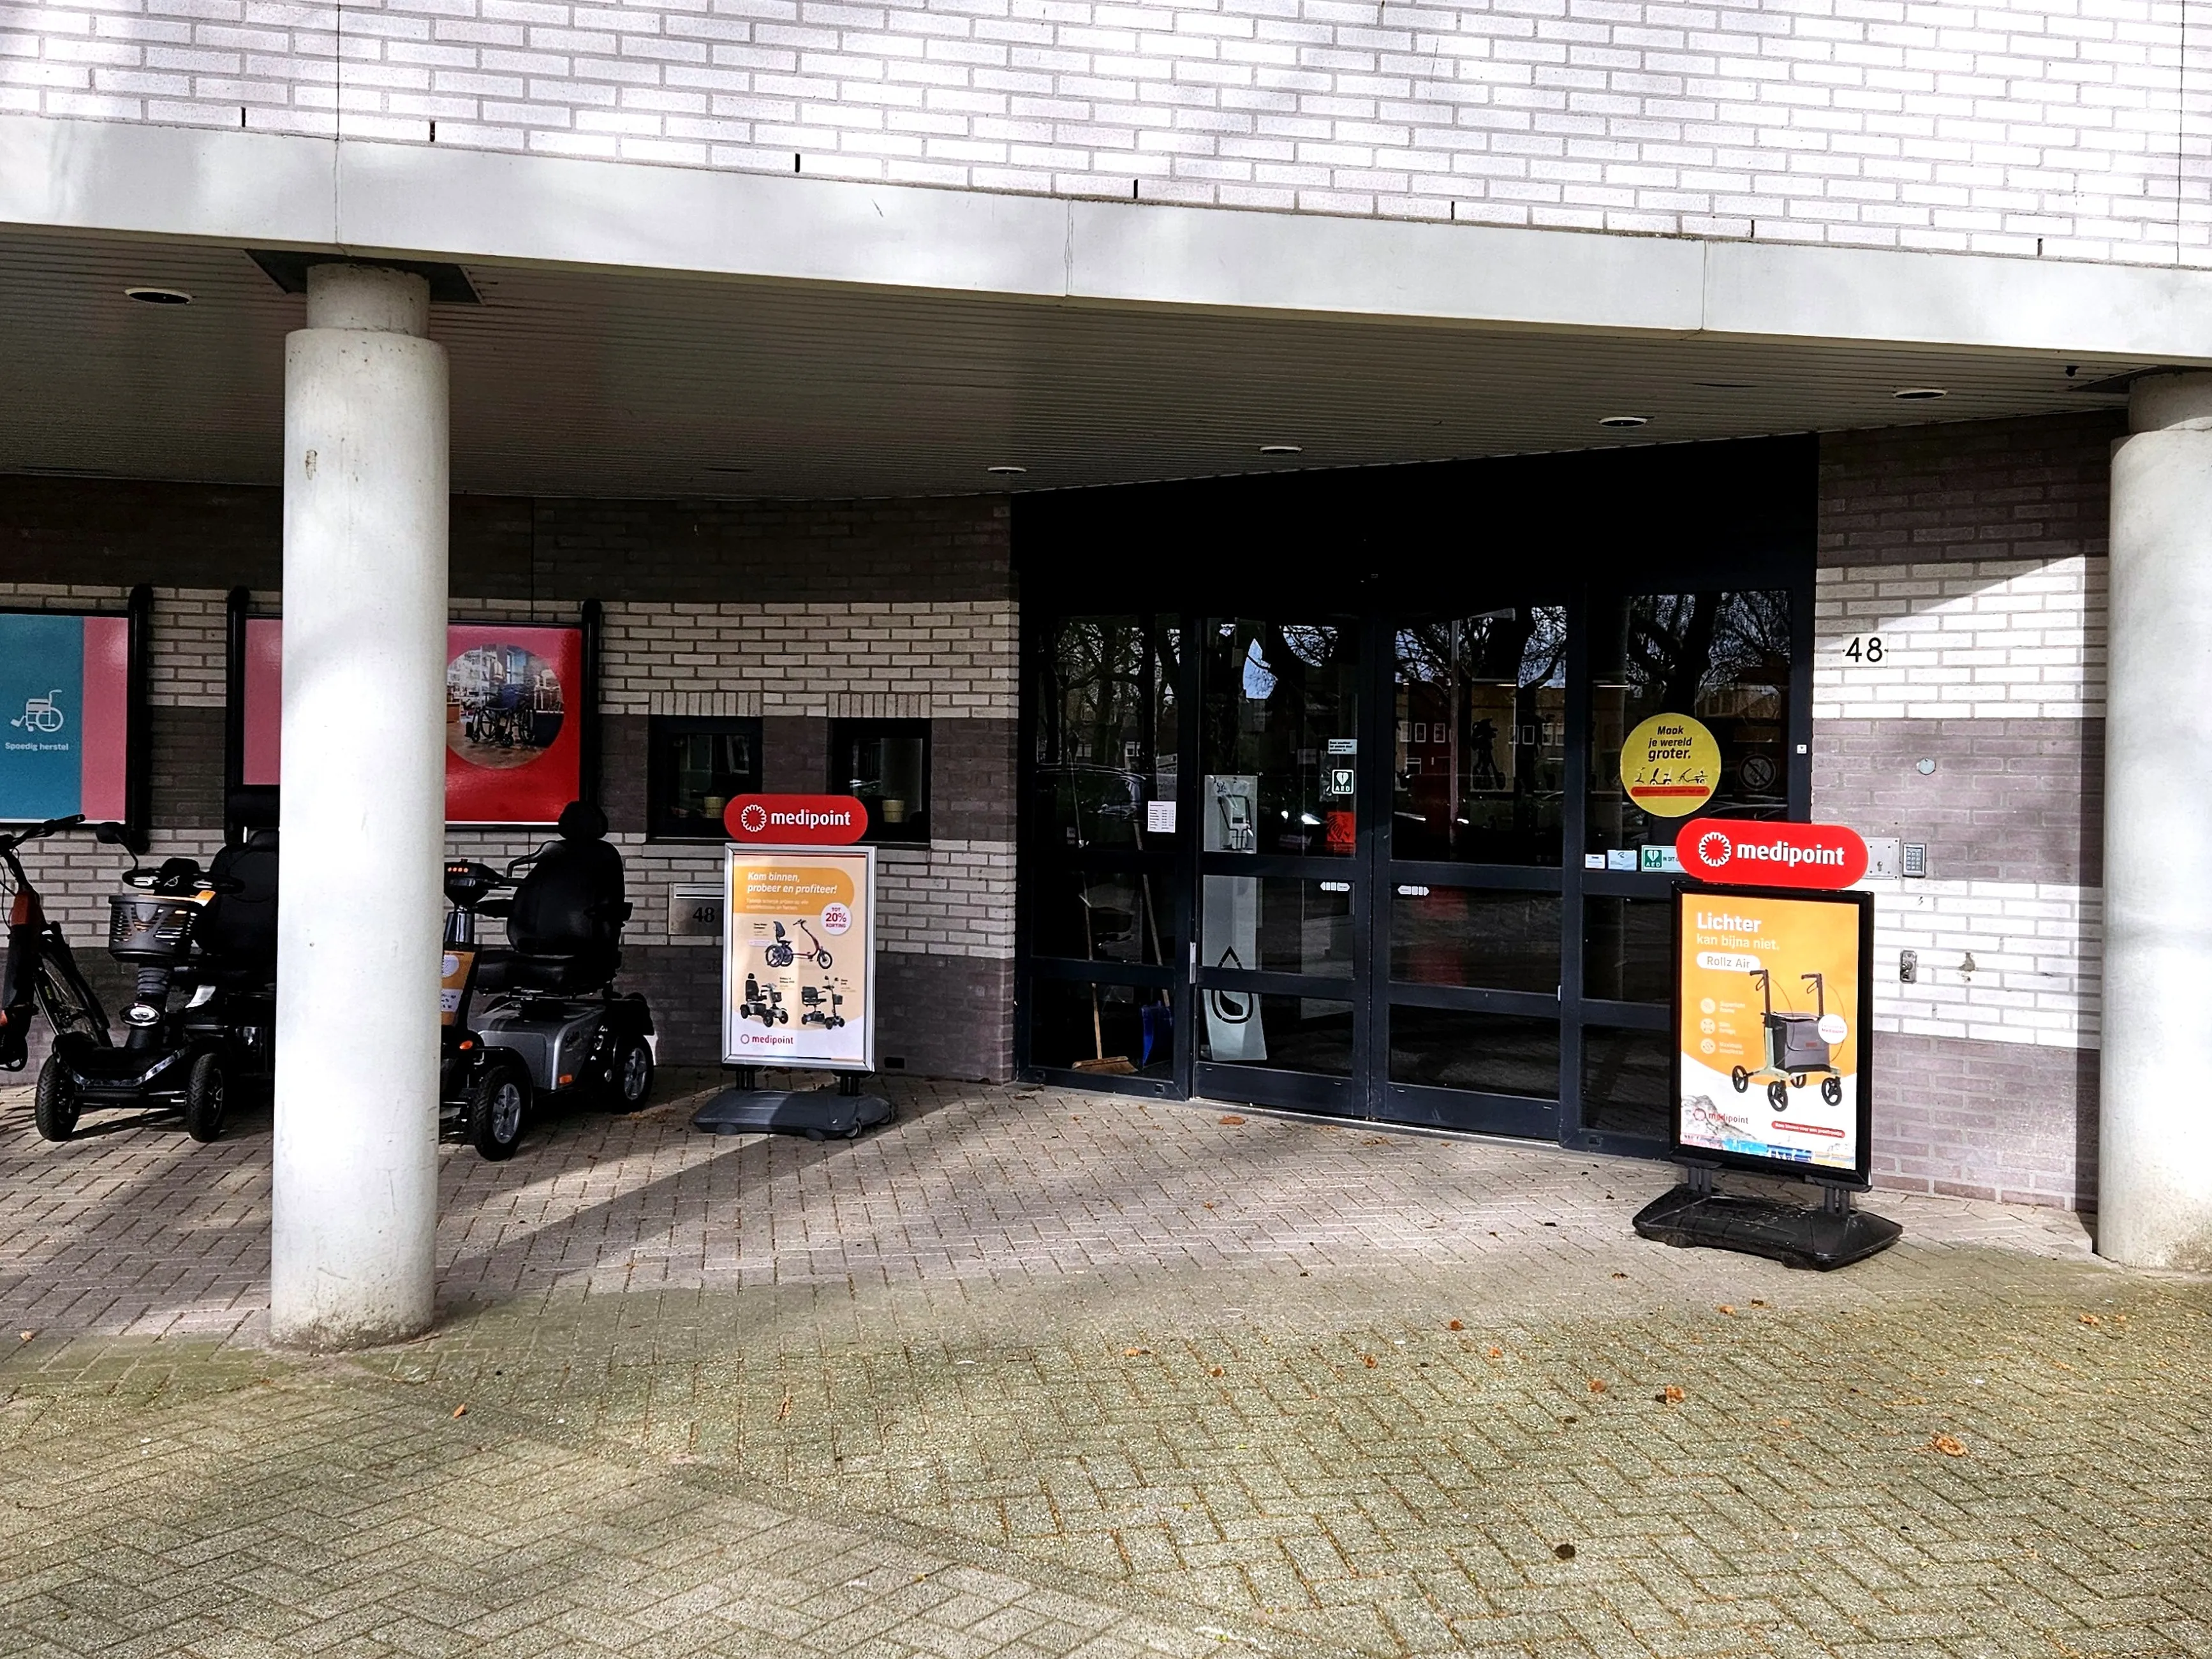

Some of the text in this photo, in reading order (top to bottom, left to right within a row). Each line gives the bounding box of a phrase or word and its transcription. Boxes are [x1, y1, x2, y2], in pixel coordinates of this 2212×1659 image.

[1845, 637, 1883, 663] 48
[1657, 725, 1684, 735] Maak
[5, 742, 38, 751] Spoedig
[1648, 737, 1692, 748] je wereld
[1648, 748, 1691, 762] groter.
[771, 809, 851, 829] medipoint
[1736, 841, 1845, 867] medipoint
[748, 872, 800, 883] Kom binnen,
[747, 883, 781, 894] probeer
[795, 885, 837, 895] profiteer!
[692, 907, 715, 923] 48
[825, 913, 847, 922] 20%
[1697, 912, 1762, 933] Lichter
[1697, 933, 1780, 951] kan bijna niet.
[1706, 955, 1751, 969] Rollz Air
[752, 1035, 793, 1045] medipoint
[1708, 1112, 1749, 1124] medipoint
